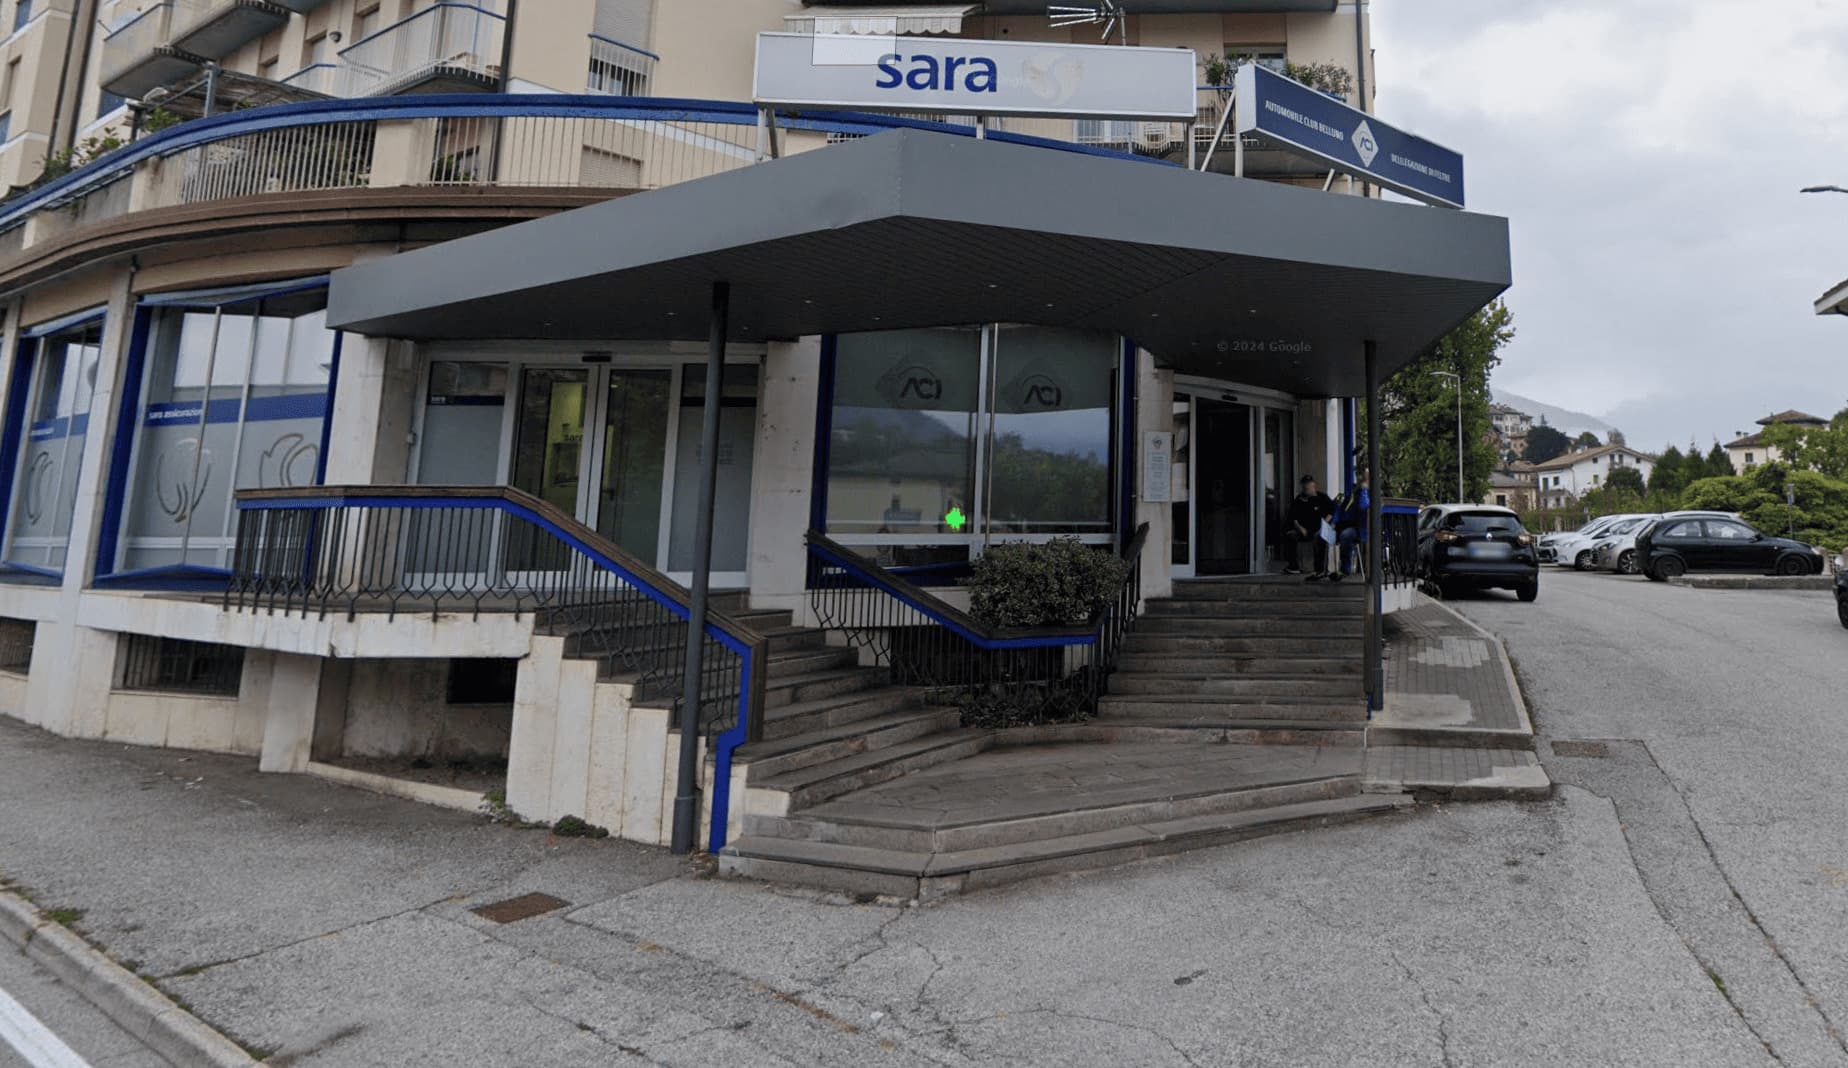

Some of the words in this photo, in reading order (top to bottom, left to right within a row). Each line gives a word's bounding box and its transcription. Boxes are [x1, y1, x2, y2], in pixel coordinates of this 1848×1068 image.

[876, 54, 997, 92] sara
[1265, 100, 1304, 124] AUTOMOBILE
[1304, 116, 1318, 130] CLUB
